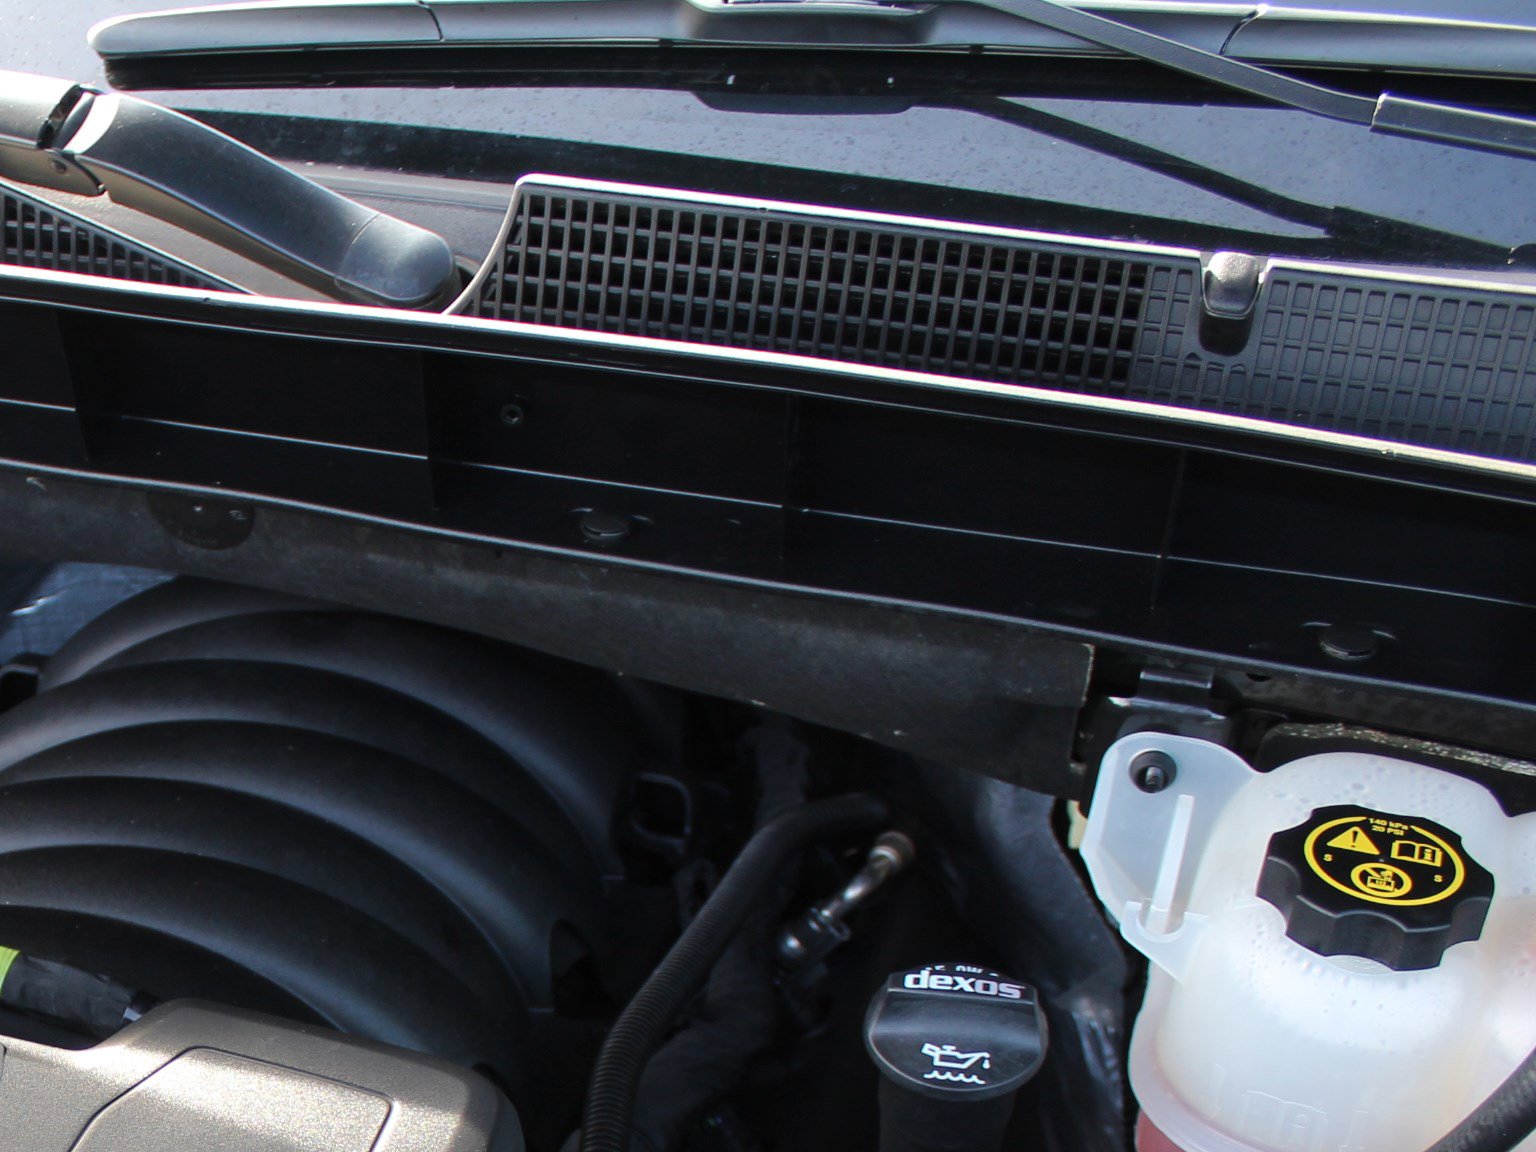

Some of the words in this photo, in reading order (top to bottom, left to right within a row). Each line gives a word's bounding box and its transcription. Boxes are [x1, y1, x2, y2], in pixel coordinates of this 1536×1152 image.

[1368, 817, 1388, 826] 140
[1388, 820, 1409, 831] kPa
[1371, 824, 1386, 833] 20
[1386, 827, 1404, 836] PSI
[904, 969, 1022, 999] dexos
